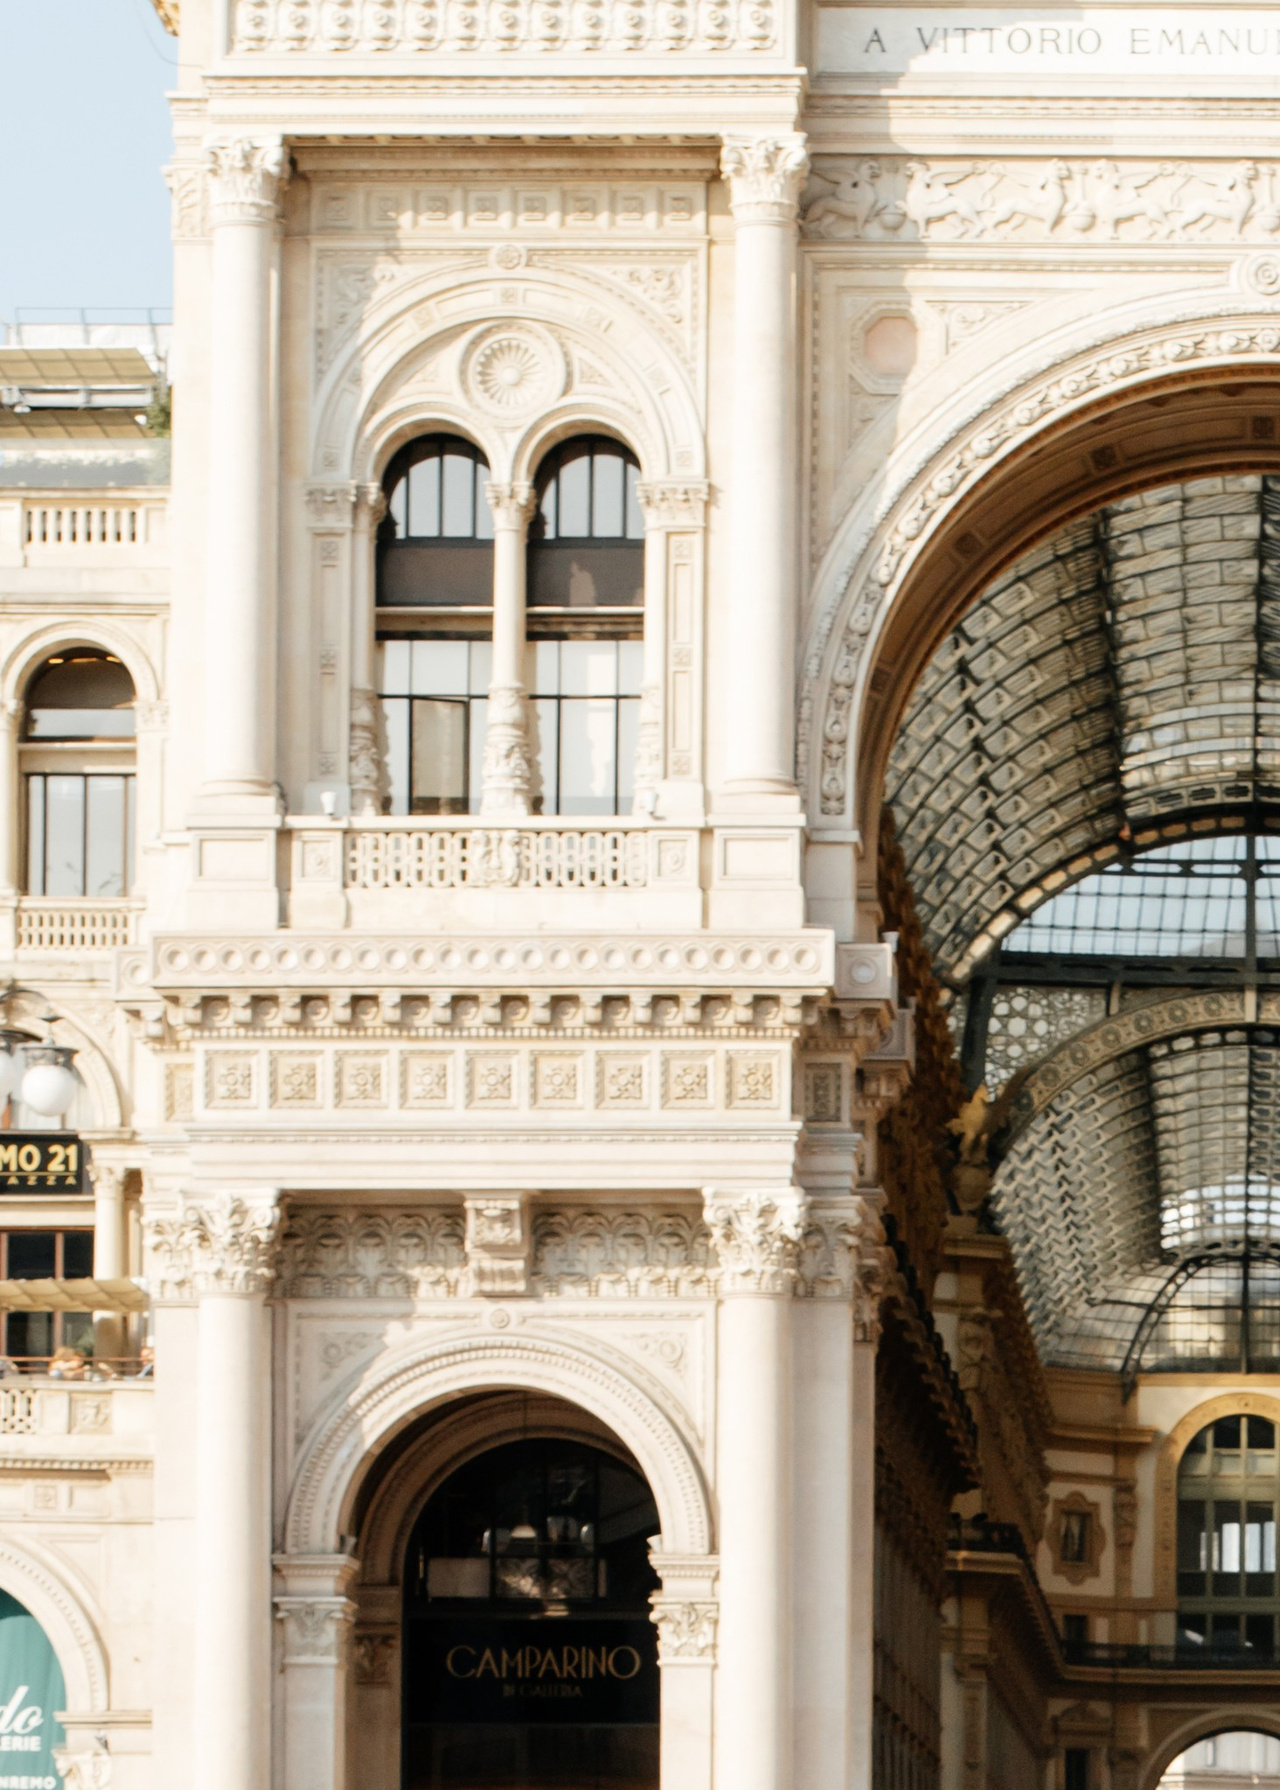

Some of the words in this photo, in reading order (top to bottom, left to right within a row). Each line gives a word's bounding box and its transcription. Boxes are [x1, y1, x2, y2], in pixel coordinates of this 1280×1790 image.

[863, 27, 888, 54] A
[916, 27, 1102, 55] VITTORIO
[47, 1143, 78, 1172] 21
[446, 1645, 641, 1680] CAMPARINO
